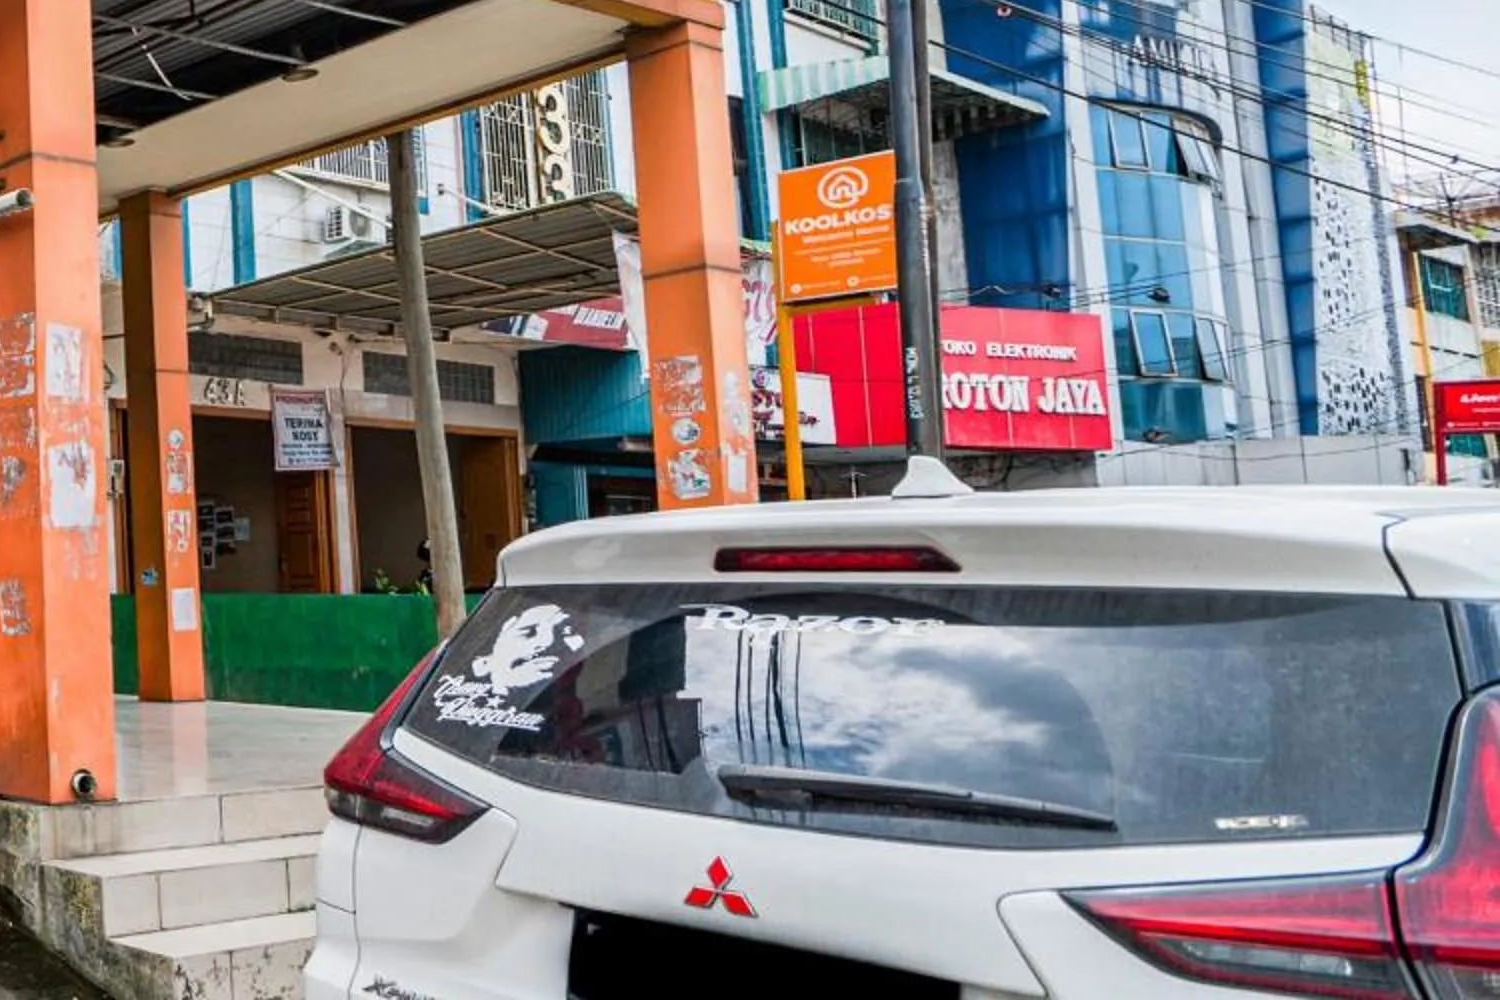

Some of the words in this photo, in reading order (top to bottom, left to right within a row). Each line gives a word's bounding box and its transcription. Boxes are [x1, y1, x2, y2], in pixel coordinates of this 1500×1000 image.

[785, 203, 894, 236] KOOLKOS
[986, 341, 1077, 361] ELEKTRONIK
[1038, 377, 1107, 415] JAYA
